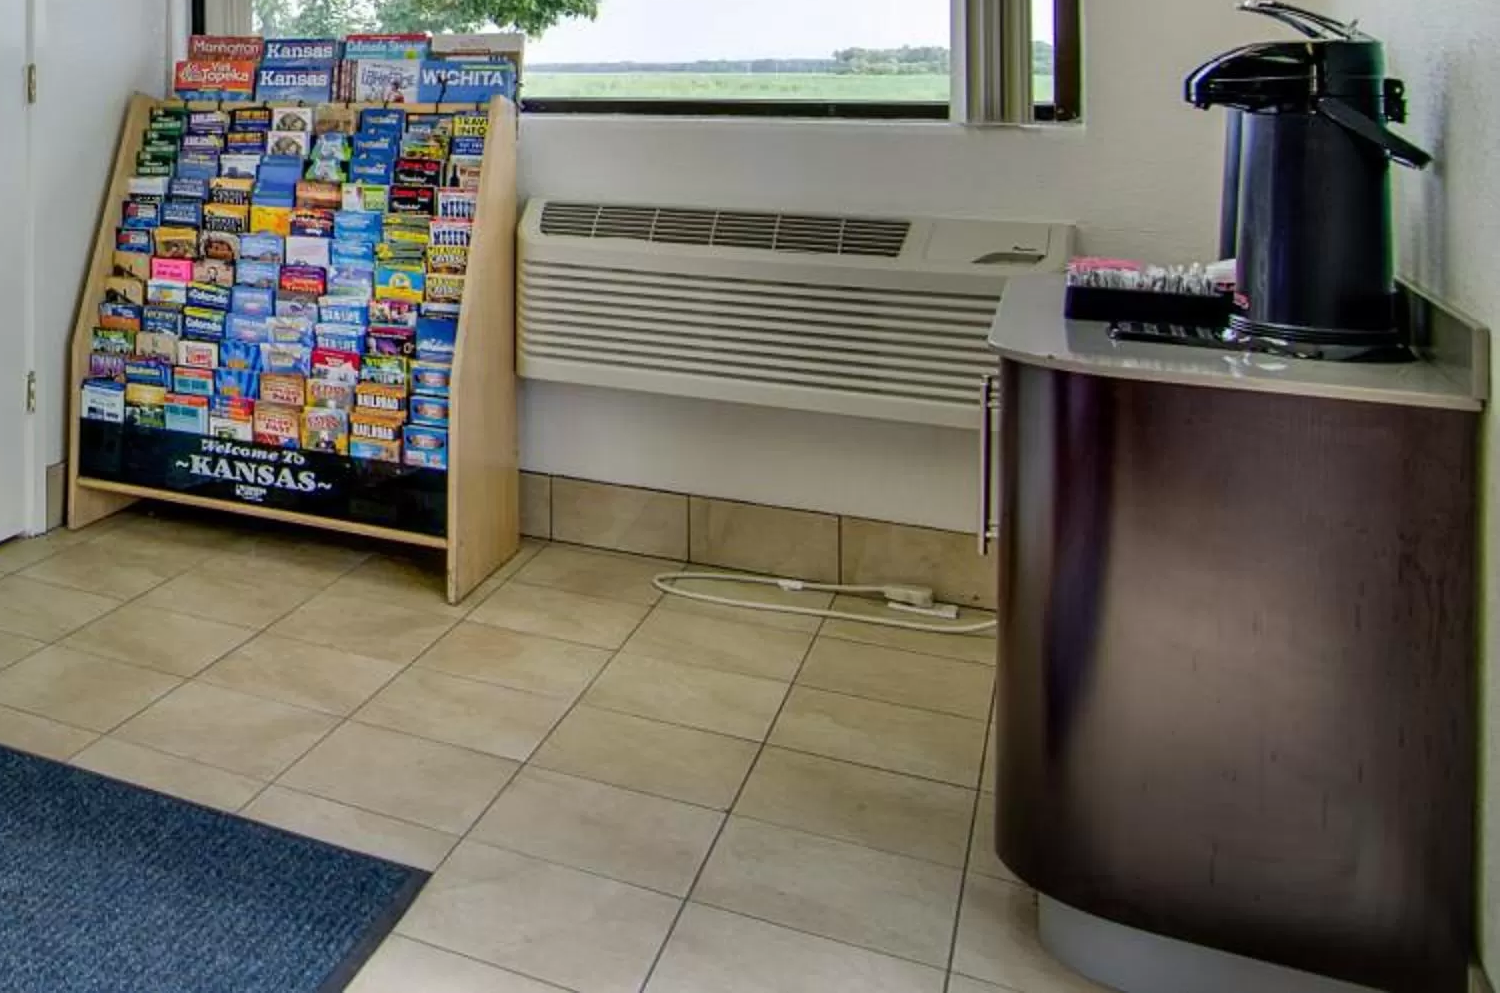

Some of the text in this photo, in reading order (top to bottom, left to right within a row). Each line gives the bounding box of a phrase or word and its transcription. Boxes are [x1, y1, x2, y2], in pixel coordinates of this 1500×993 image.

[193, 40, 259, 54] Manhattan
[267, 43, 333, 58] Kansas
[201, 68, 249, 84] Topeka
[260, 70, 329, 86] Kansas
[422, 69, 504, 86] WICHITA
[202, 439, 306, 466] Welcome To
